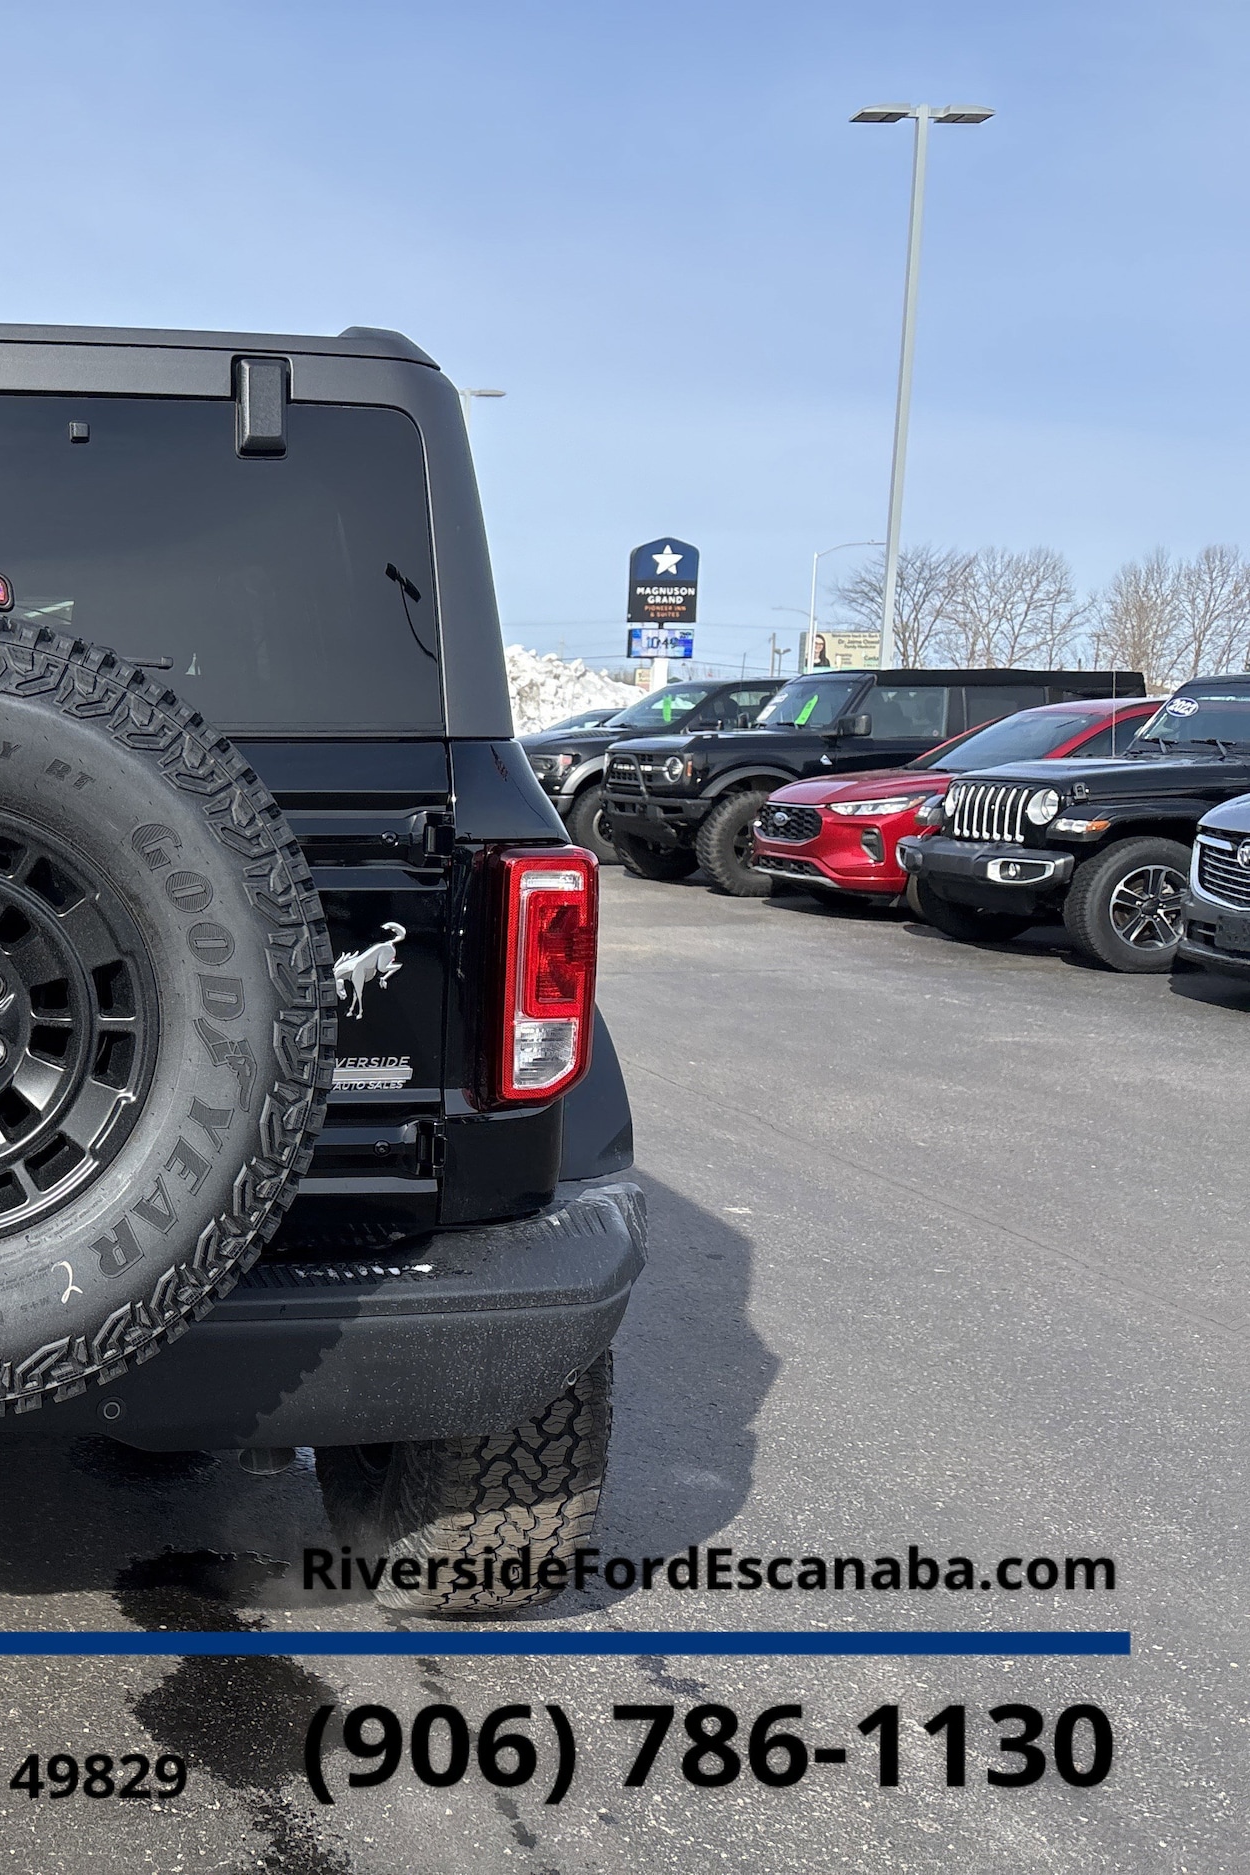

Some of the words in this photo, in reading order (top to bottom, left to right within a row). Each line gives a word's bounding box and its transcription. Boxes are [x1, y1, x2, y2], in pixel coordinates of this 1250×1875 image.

[636, 586, 696, 596] MAGNUSON
[647, 595, 684, 605] GRAND
[1168, 698, 1196, 716] 2023
[45, 758, 96, 790] RT
[88, 823, 247, 1279] GOODYEAR
[335, 1056, 411, 1069] VERSIDE
[333, 1080, 367, 1091] AUTO
[367, 1080, 405, 1090] SALES
